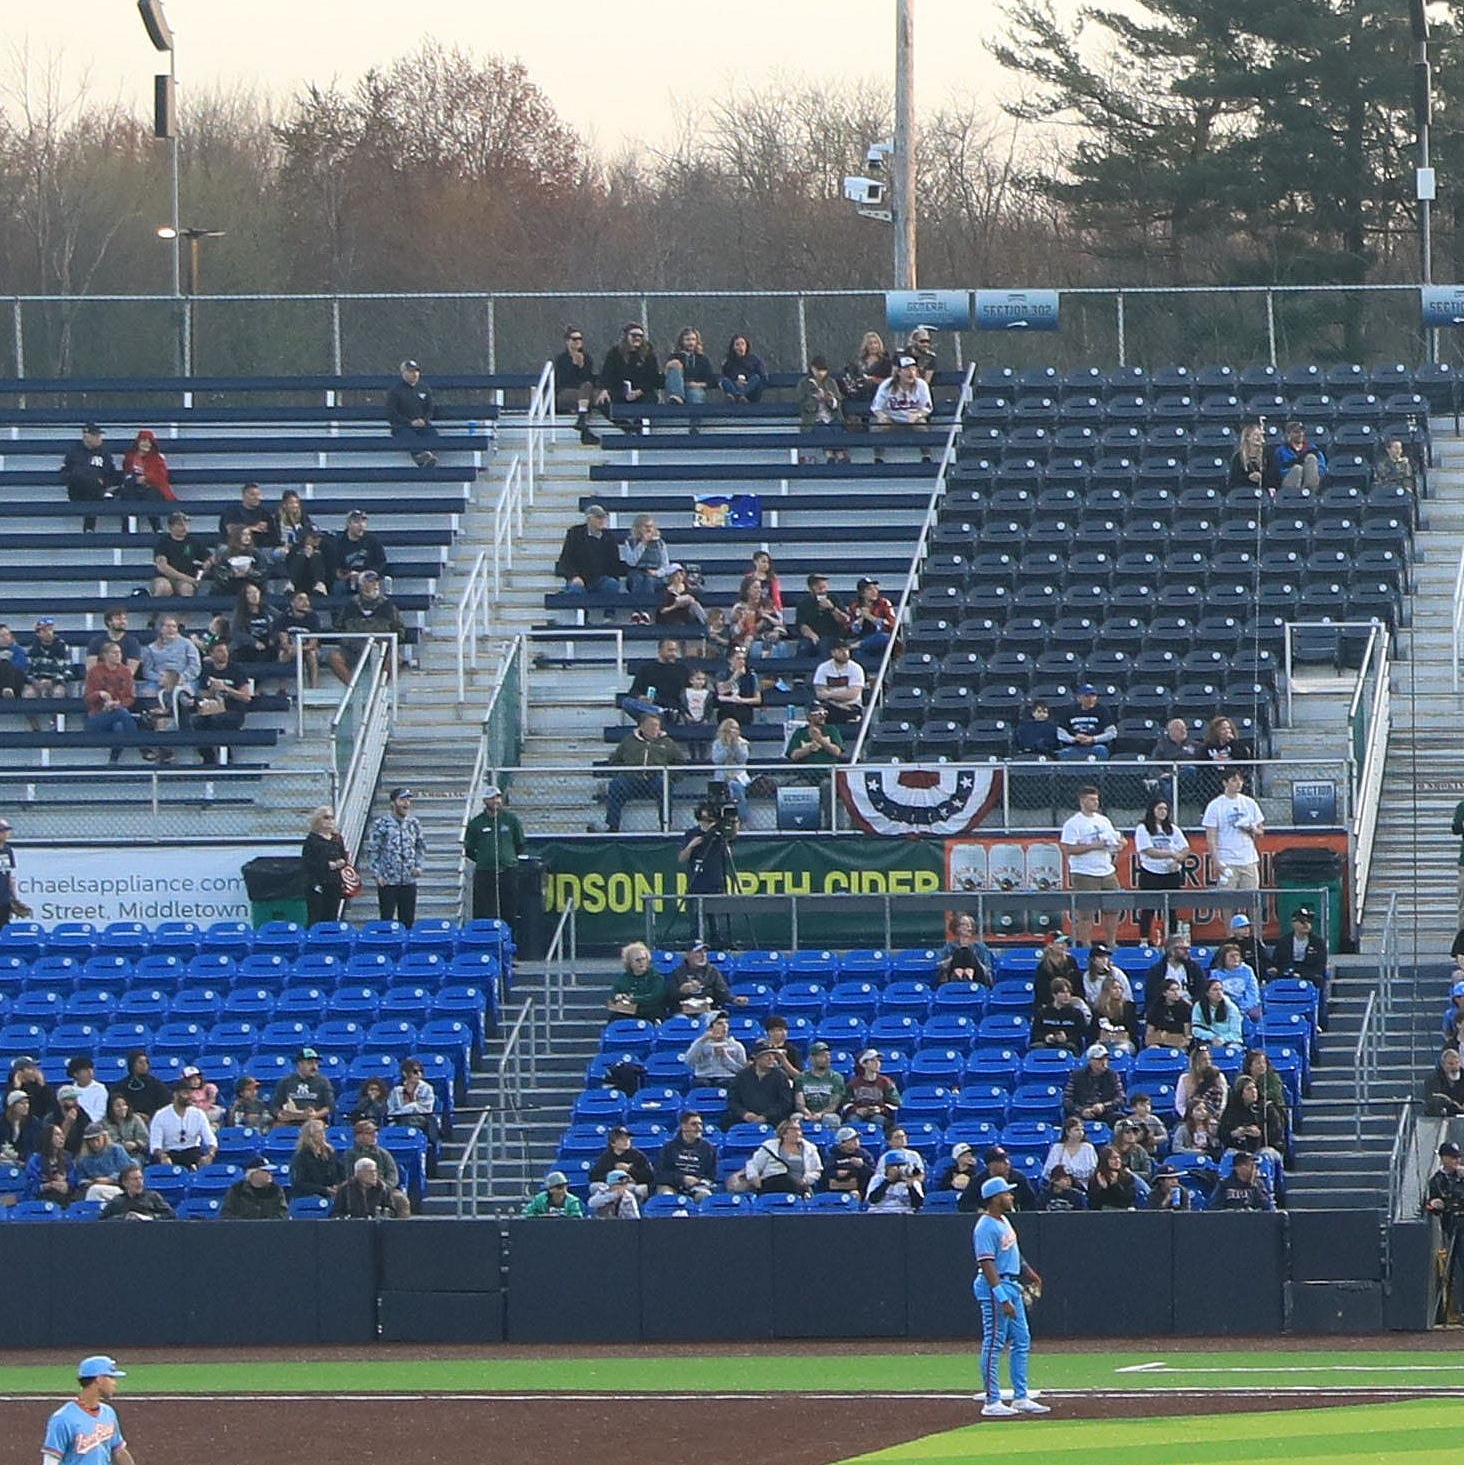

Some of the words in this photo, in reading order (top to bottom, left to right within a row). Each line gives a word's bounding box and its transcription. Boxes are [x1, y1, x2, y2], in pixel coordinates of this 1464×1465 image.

[20, 875, 245, 896] chaelsappliance.com
[544, 872, 664, 913] DSON
[41, 902, 110, 920] Street,
[119, 901, 250, 920] Middletown
